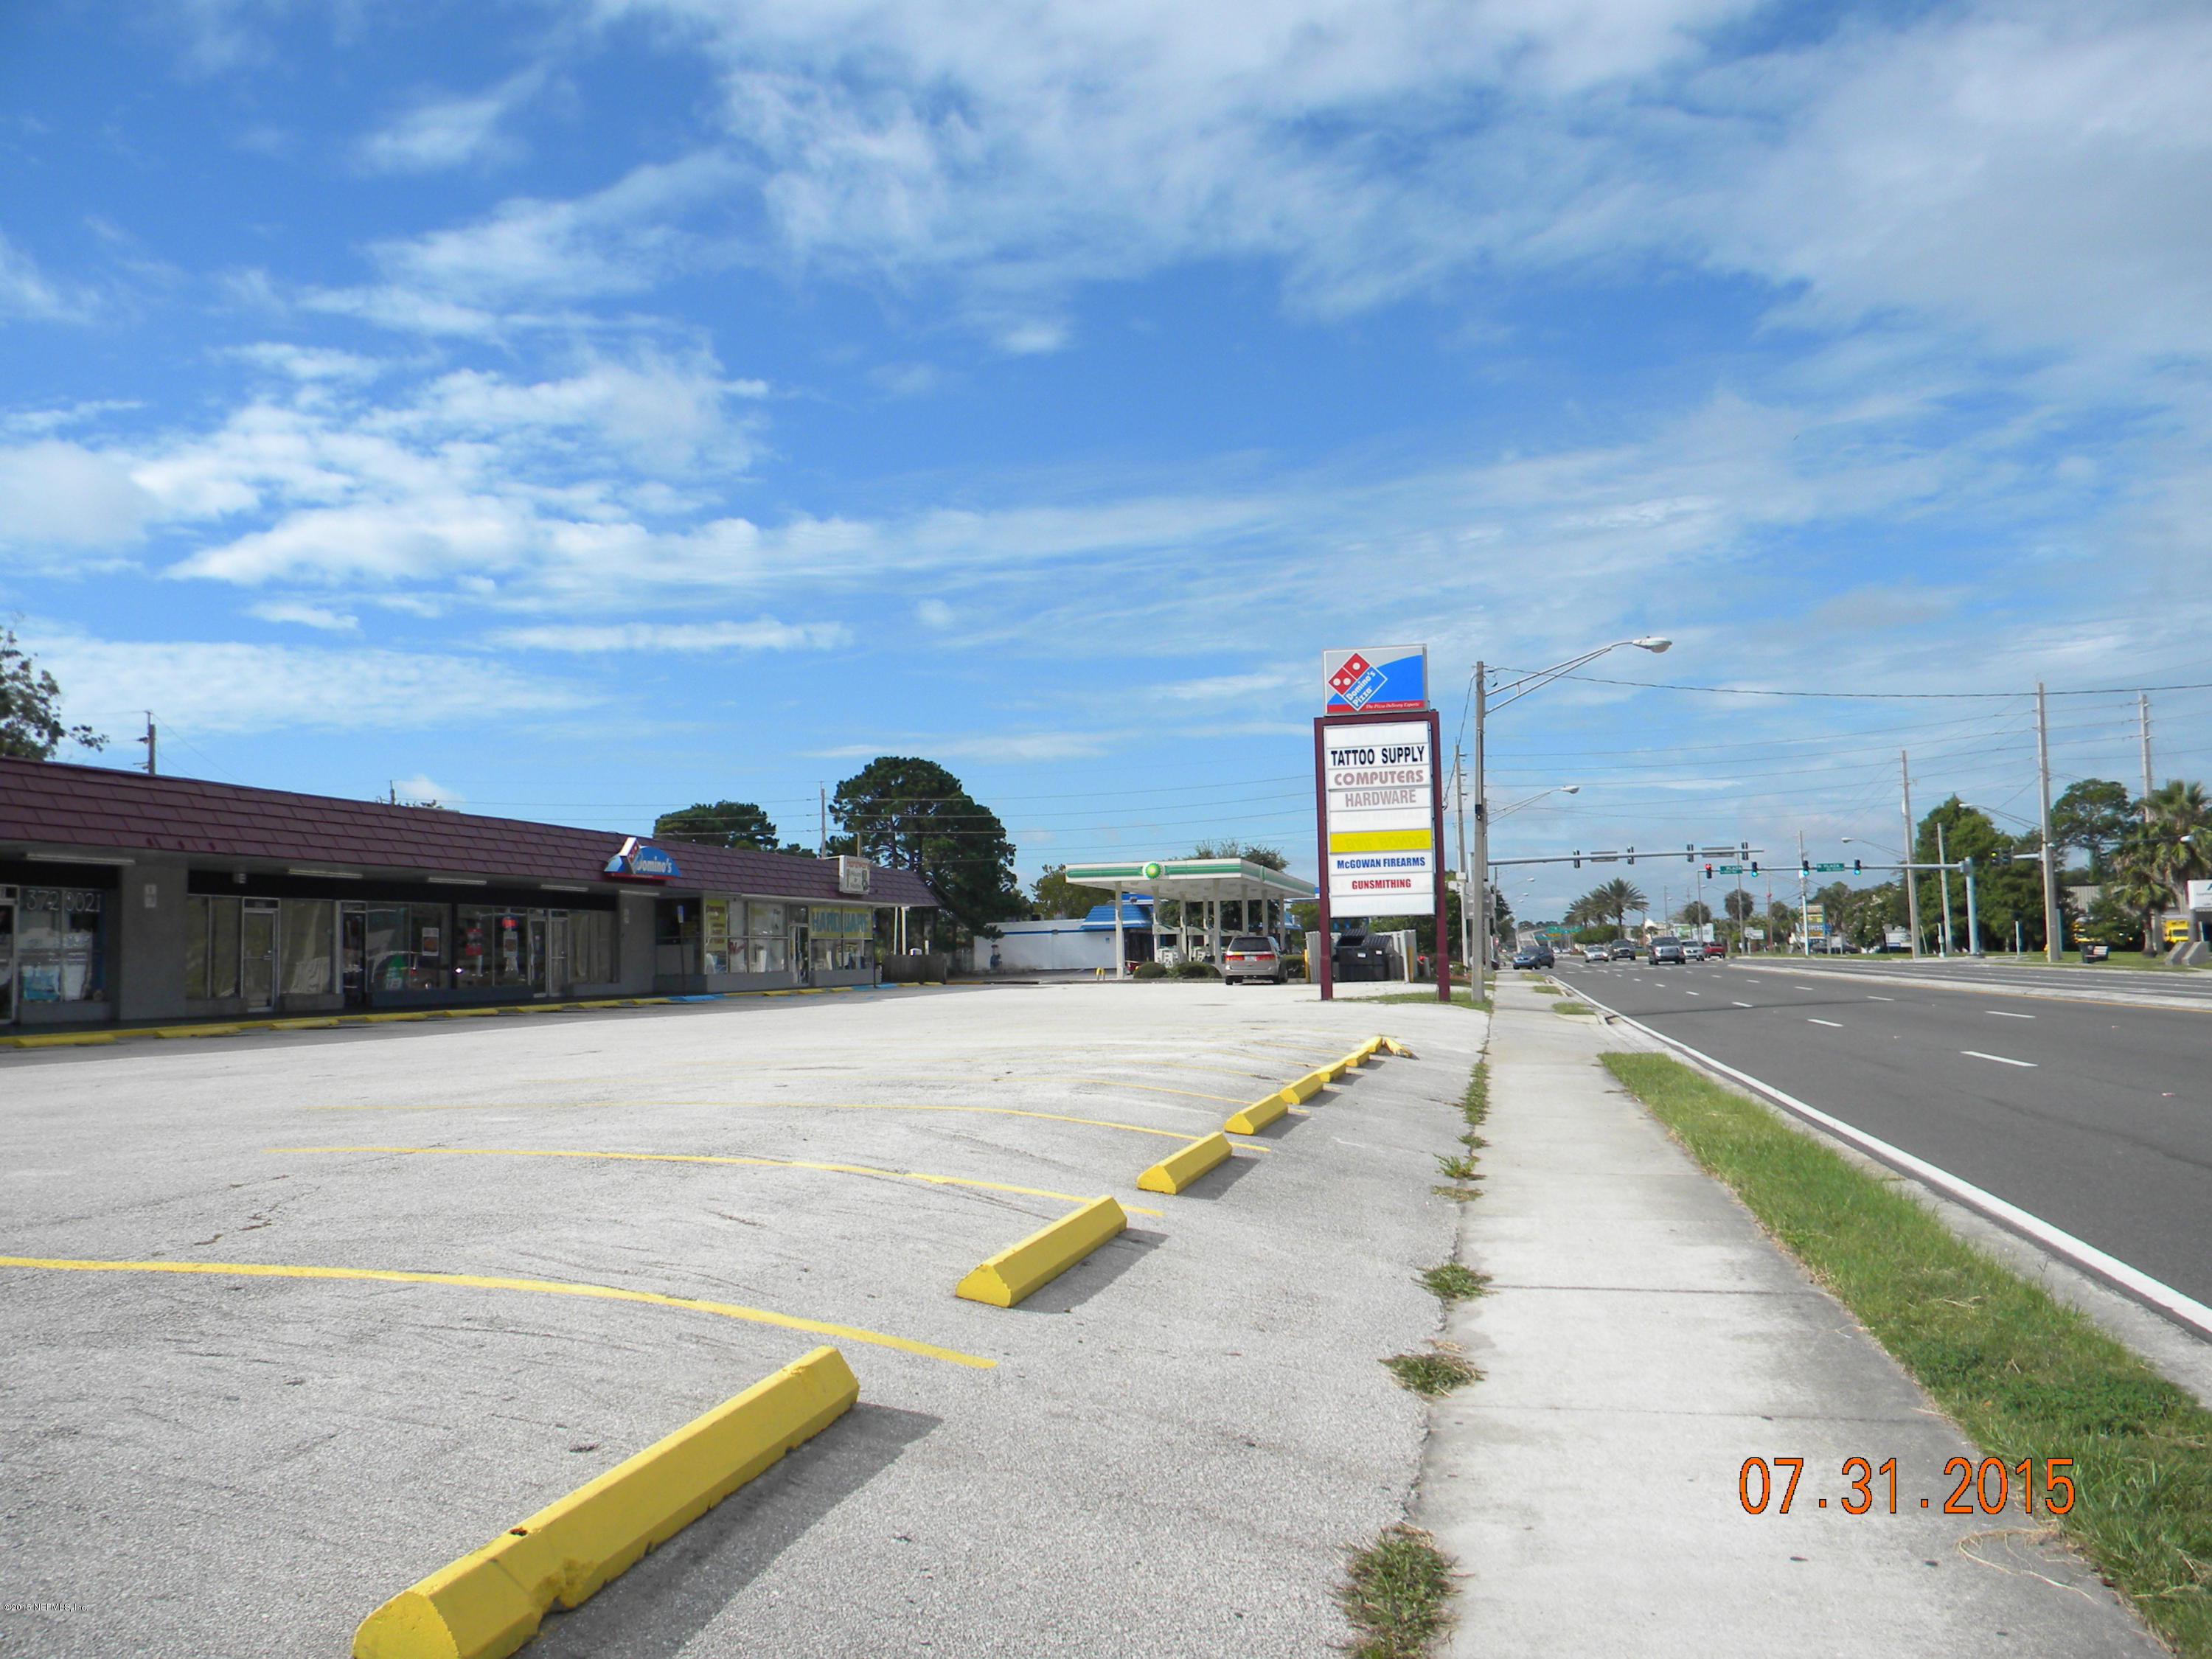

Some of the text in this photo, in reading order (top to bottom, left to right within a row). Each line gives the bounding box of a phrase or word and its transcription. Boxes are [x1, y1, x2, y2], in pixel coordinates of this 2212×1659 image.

[1345, 670, 1376, 701] Domino's
[1352, 687, 1373, 706] Pizza
[1331, 745, 1425, 766] TATTOO SUPPLY
[1334, 770, 1424, 786] COMPUTERS
[1345, 789, 1416, 807] HARDWARE
[1337, 857, 1425, 869] McGOWAN FIREARMS
[1352, 878, 1411, 890] GUNSMITHING
[811, 911, 869, 933] HARDWARE
